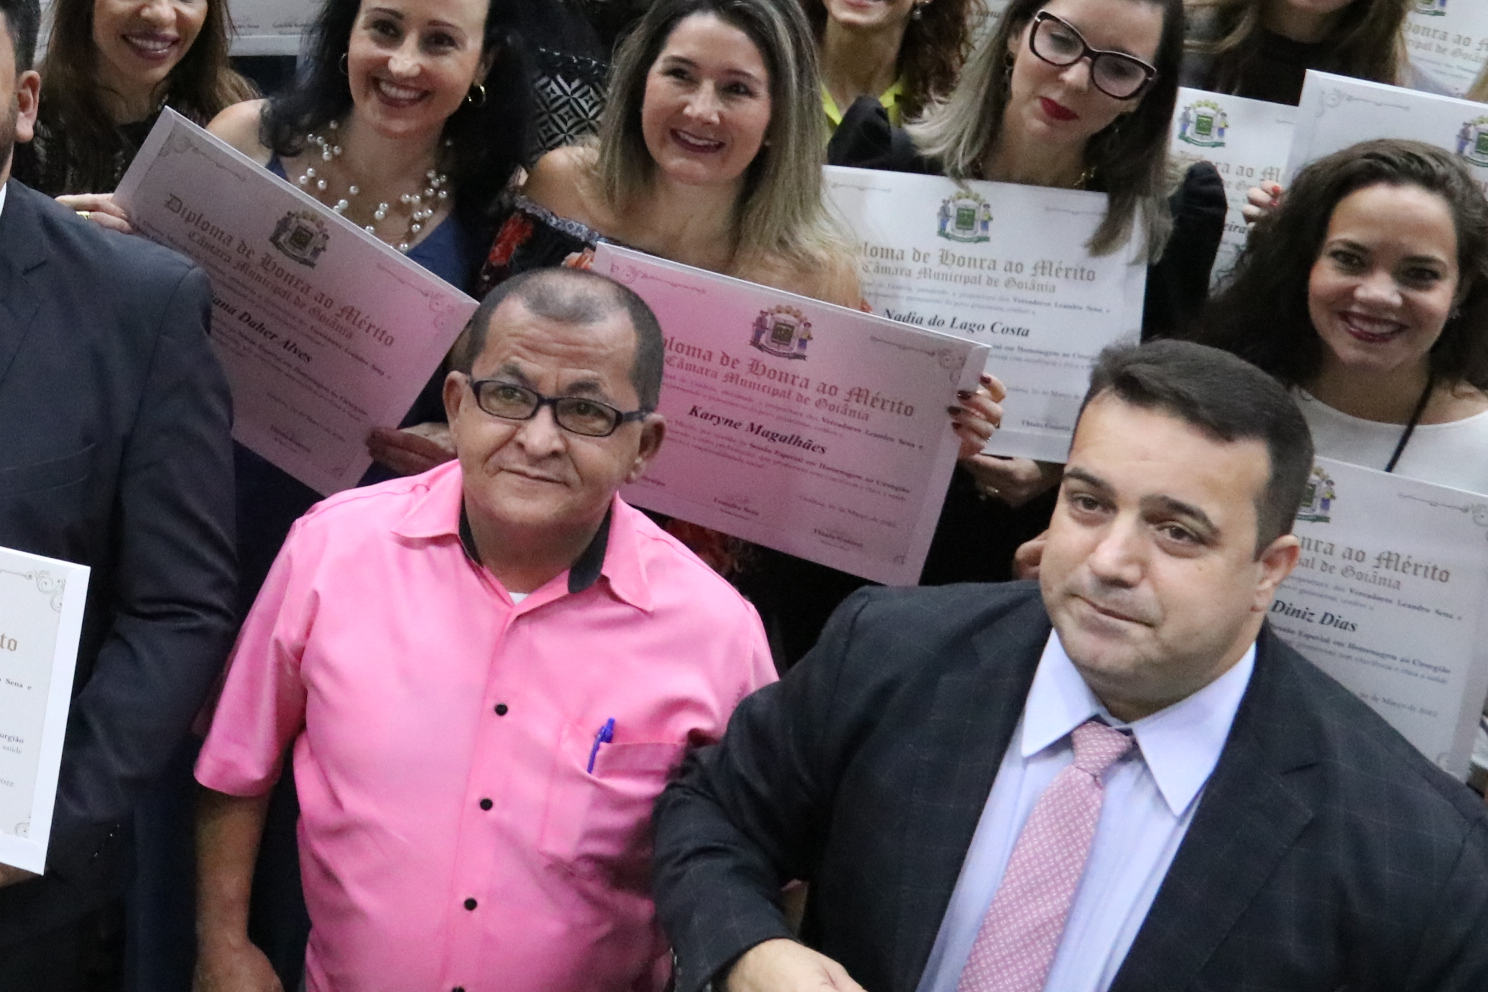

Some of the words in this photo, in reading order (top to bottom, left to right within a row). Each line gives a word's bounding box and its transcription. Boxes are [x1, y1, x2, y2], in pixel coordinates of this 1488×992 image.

[164, 193, 238, 249] Diploma
[237, 240, 256, 258] de
[260, 256, 312, 294] Honra
[314, 291, 334, 309] ao
[334, 304, 396, 348] Mérito
[912, 248, 930, 264] de
[938, 248, 997, 272] Honra
[1004, 260, 1024, 275] ao
[1032, 259, 1096, 282] Mérito
[239, 310, 278, 342] Daher
[281, 339, 312, 363] Alves
[883, 309, 923, 327] Nadia
[928, 314, 945, 327] do
[950, 316, 985, 334] Lago
[990, 320, 1030, 337] Costa
[720, 350, 740, 370] de
[748, 360, 810, 391] Honra
[816, 380, 839, 397] ao
[844, 386, 915, 418] Mérito
[688, 404, 743, 434] Karyne
[746, 421, 827, 455] Magalhães
[1319, 560, 1336, 574] de
[1341, 566, 1402, 591] Goiânia
[1343, 545, 1367, 564] ao
[1373, 550, 1451, 584] Mérito
[1271, 599, 1314, 625] Diniz
[1319, 609, 1359, 633] Dias
[5, 678, 23, 688] Sena
